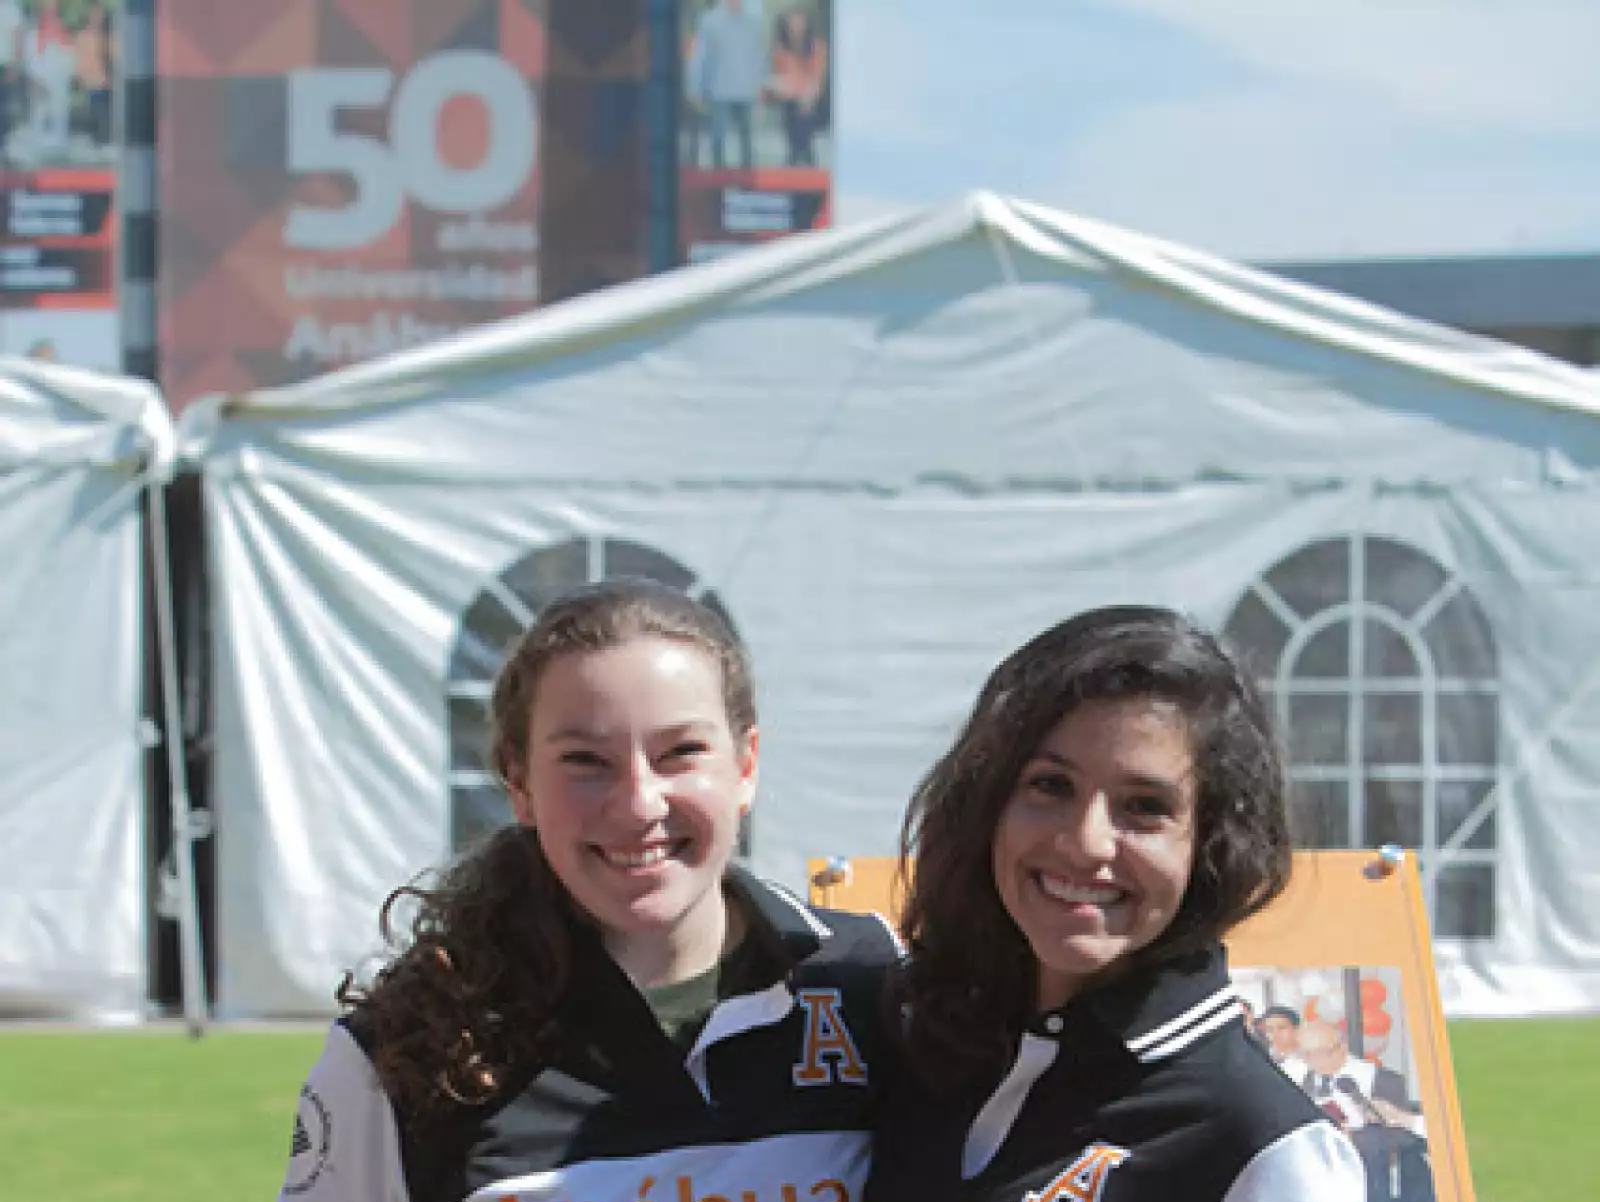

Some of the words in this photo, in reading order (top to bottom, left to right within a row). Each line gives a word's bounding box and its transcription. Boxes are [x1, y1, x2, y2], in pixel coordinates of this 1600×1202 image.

[282, 48, 538, 250] 50
[283, 264, 539, 300] Universidad
[792, 986, 868, 1085] A
